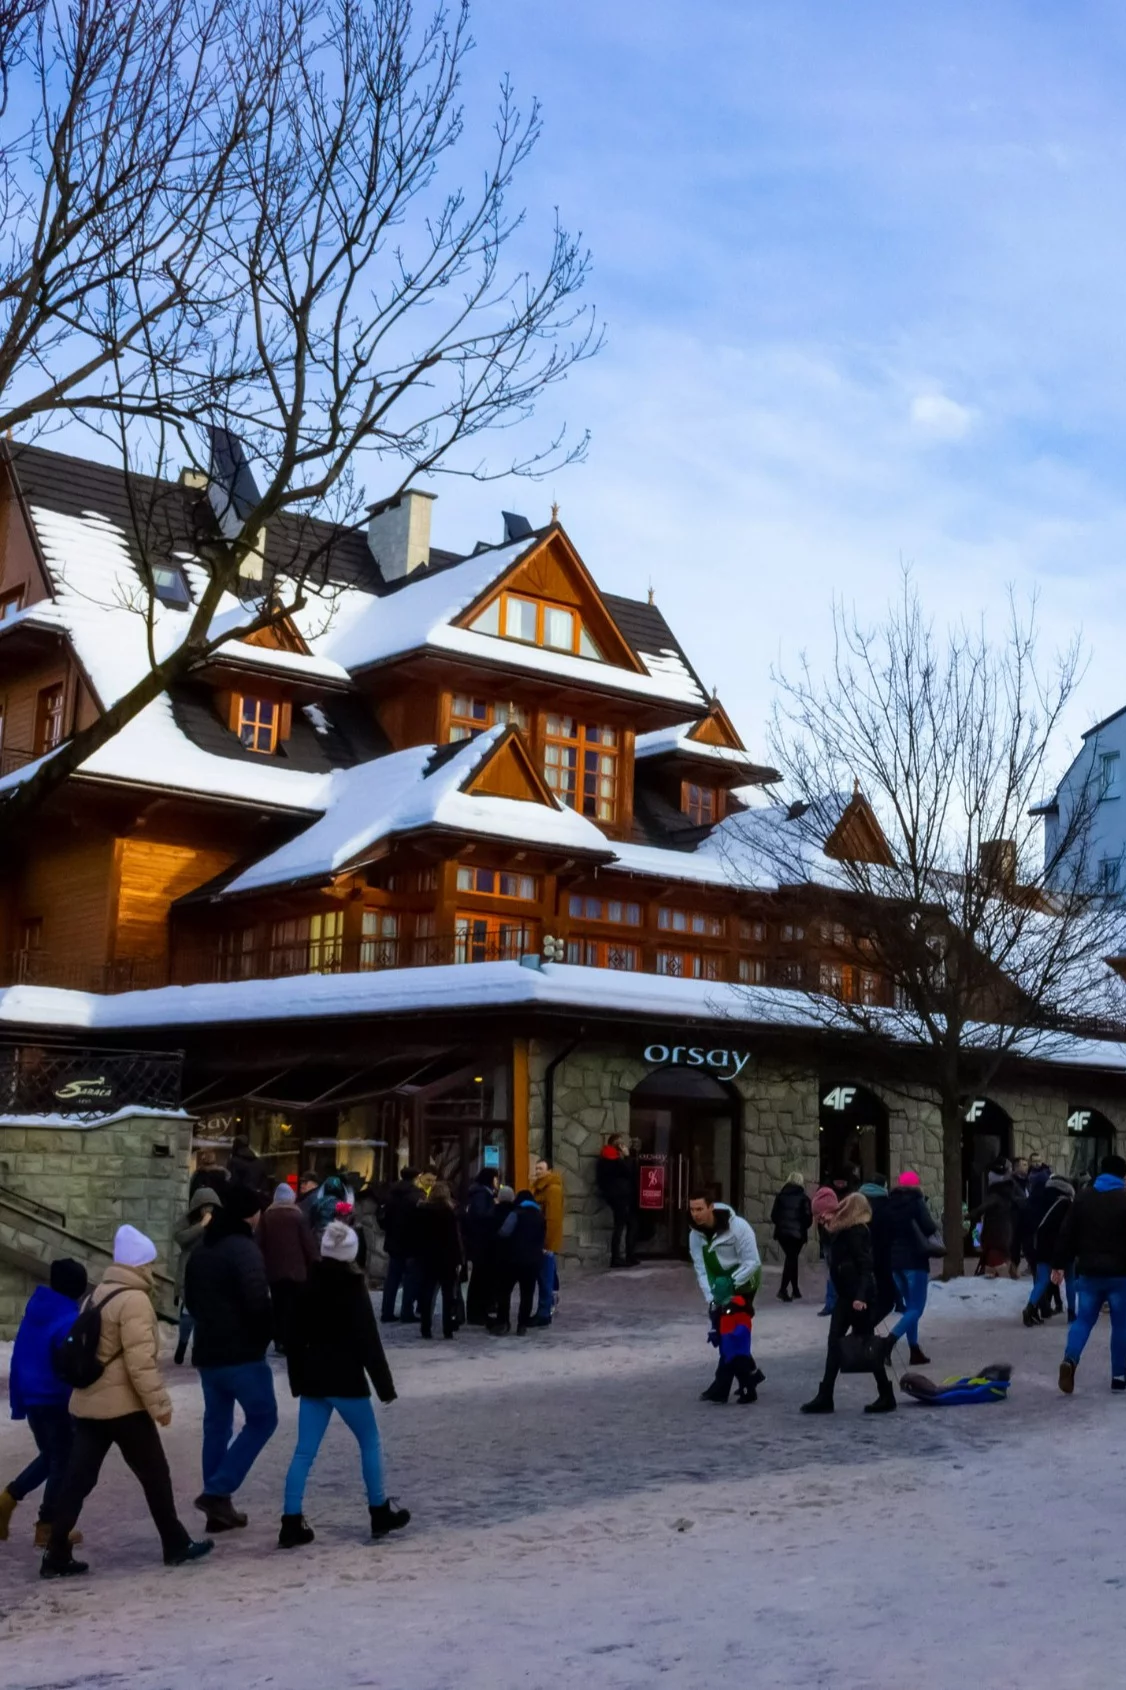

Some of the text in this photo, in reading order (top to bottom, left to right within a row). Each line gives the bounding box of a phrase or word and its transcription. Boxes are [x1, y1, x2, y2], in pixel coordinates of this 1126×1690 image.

[643, 1044, 751, 1081] orsay
[822, 1086, 857, 1111] 4F
[1067, 1110, 1092, 1131] 4F
